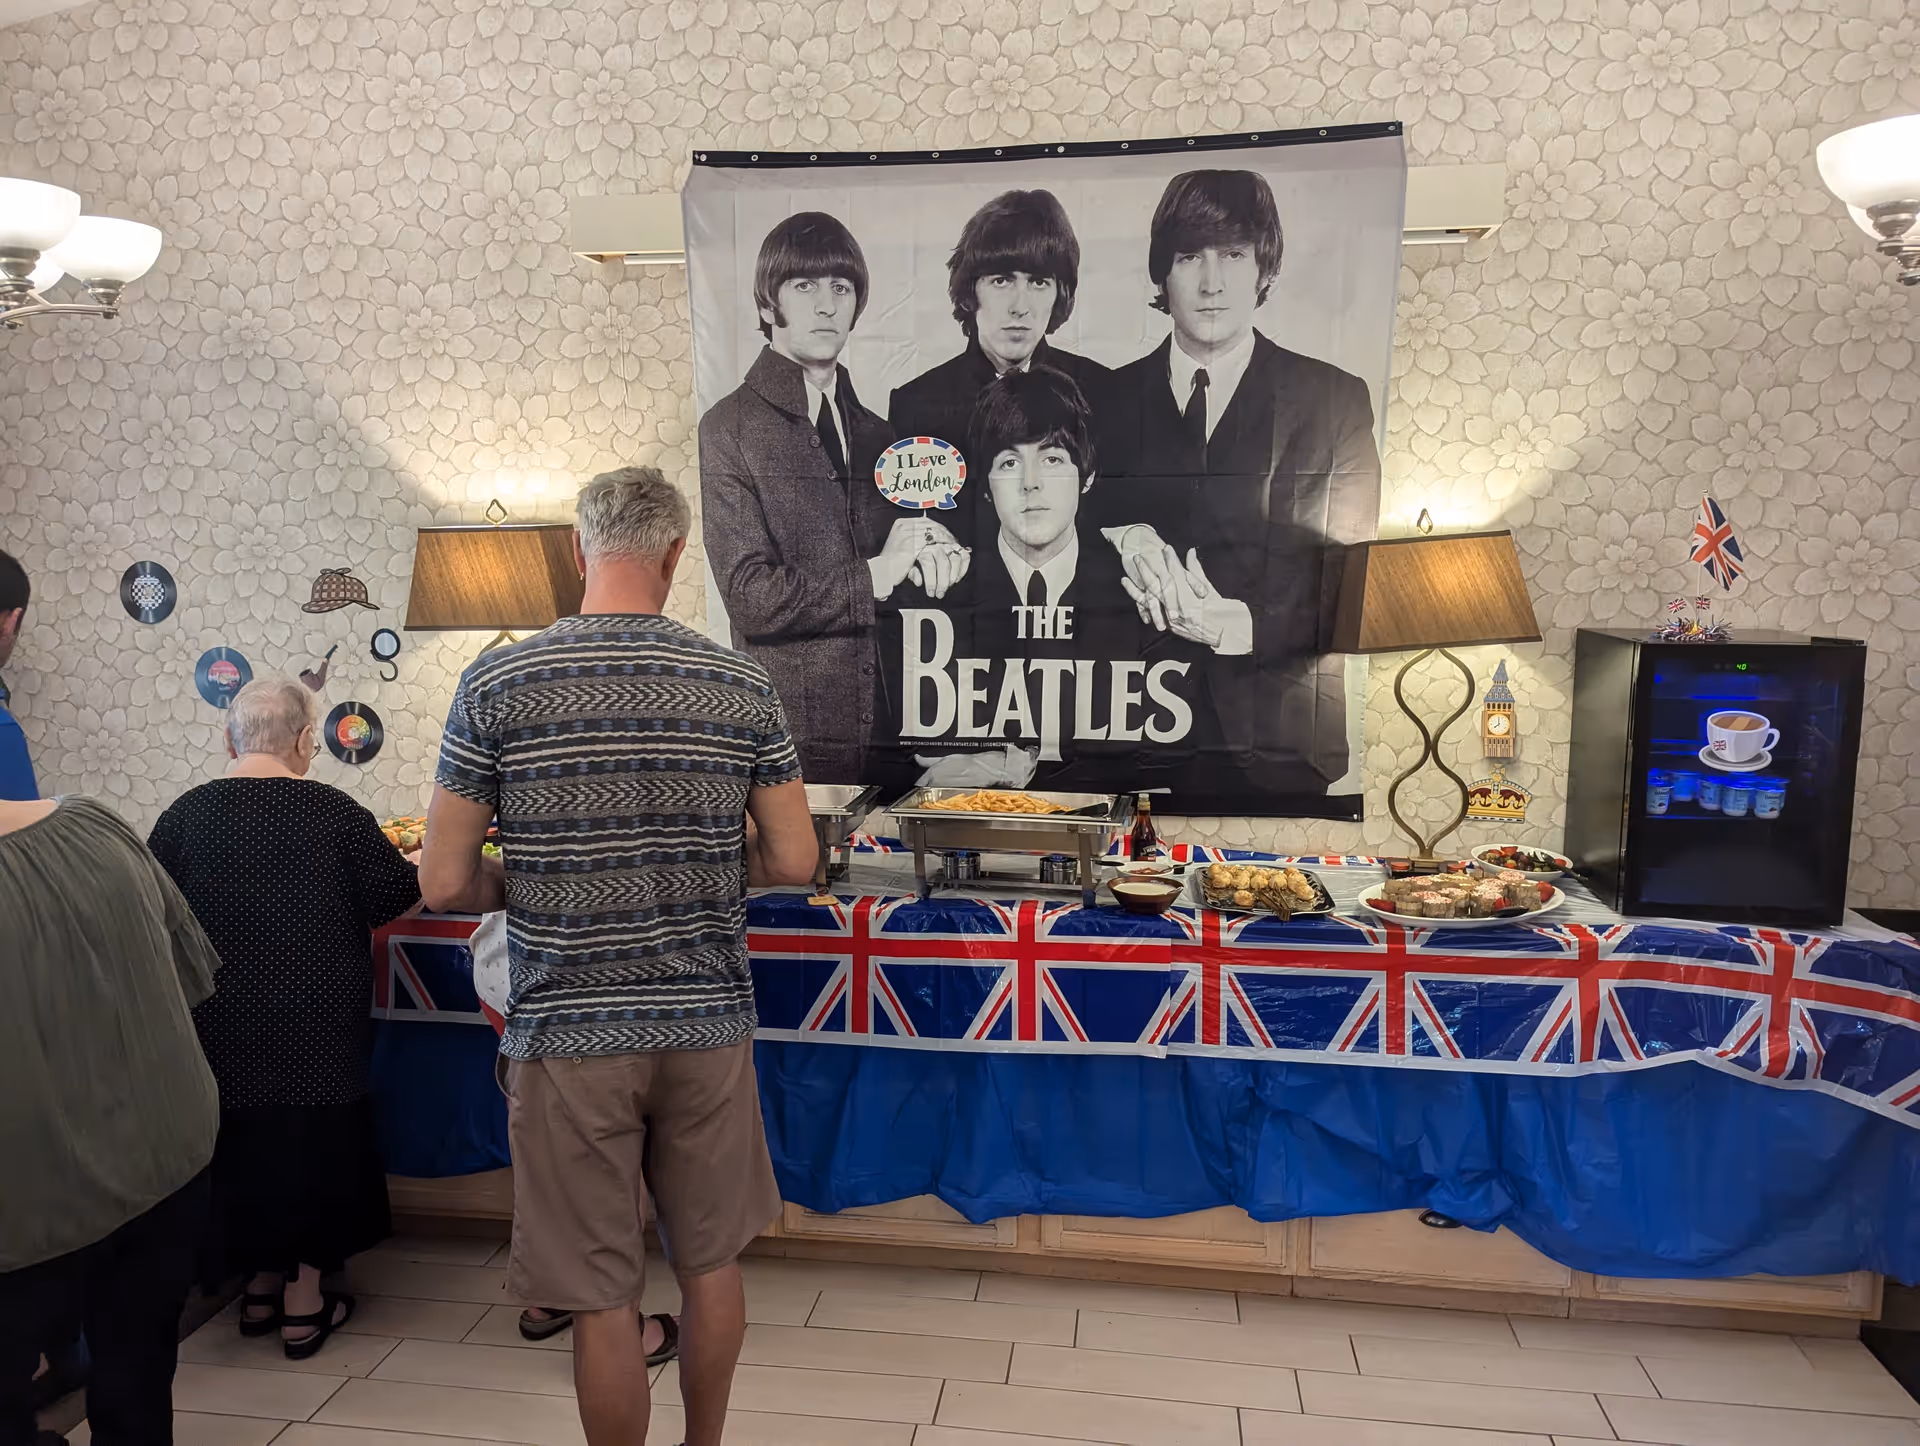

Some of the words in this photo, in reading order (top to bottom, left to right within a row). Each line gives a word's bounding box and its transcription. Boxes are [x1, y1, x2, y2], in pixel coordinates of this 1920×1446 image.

[896, 454, 904, 469] I
[889, 469, 954, 493] London
[1011, 605, 1074, 640] THE
[898, 608, 1193, 762] BEATLES
